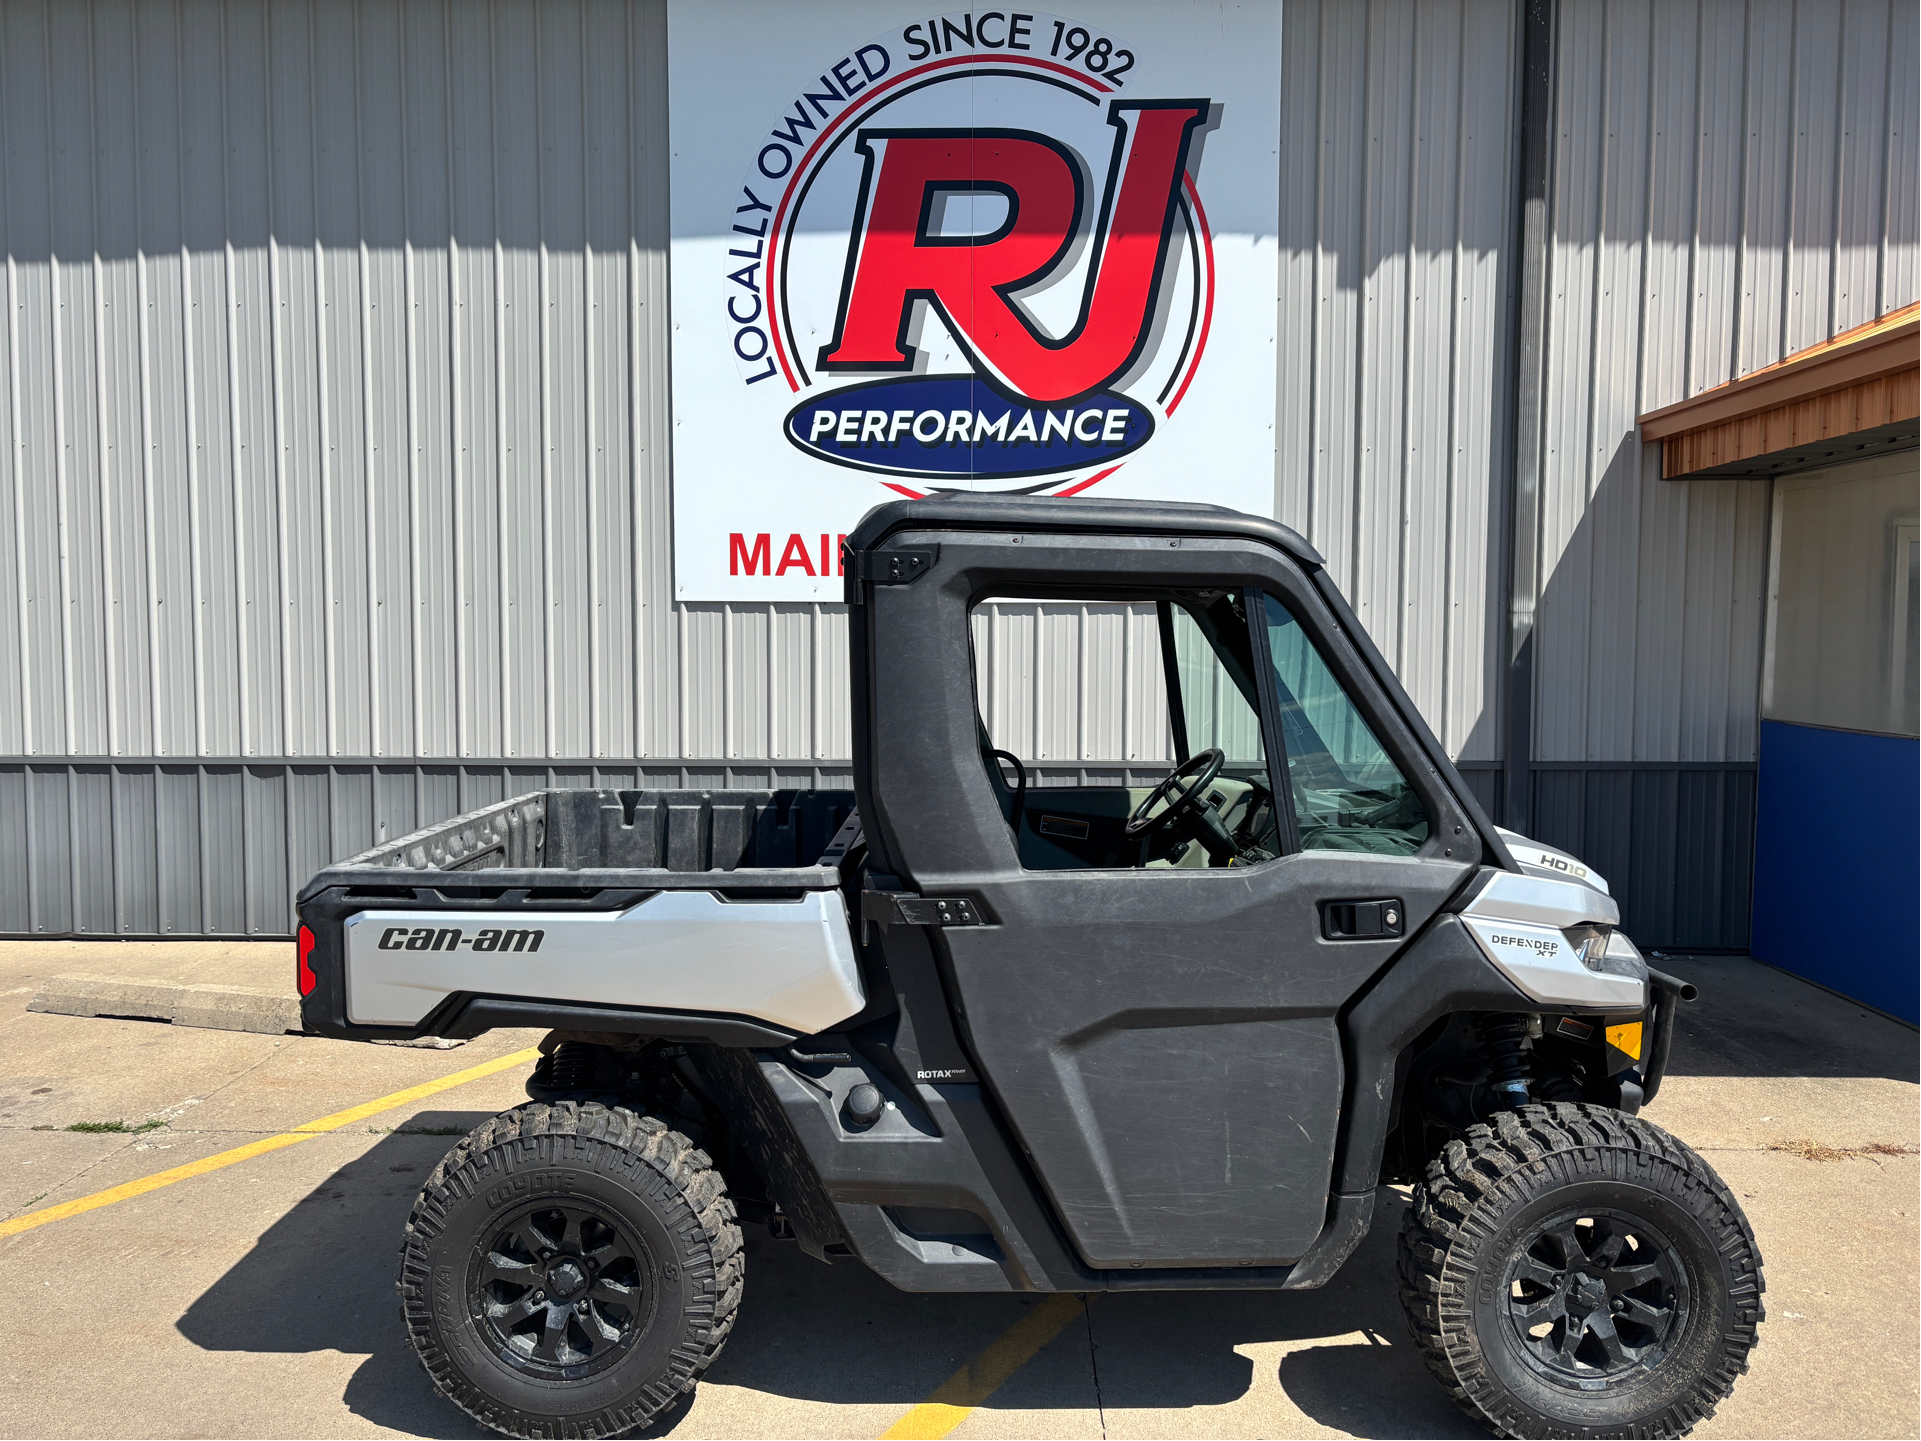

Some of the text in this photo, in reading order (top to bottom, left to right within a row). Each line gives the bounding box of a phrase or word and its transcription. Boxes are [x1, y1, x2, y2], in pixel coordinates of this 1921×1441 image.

[727, 12, 1135, 384] LOCALLY OWNED SINCE 1982
[816, 98, 1210, 408] RJ
[809, 410, 1129, 442] PERFORMANCE
[1541, 855, 1587, 878] HD10
[378, 928, 545, 952] can-am
[1491, 935, 1559, 950] DEFENDER
[917, 1070, 952, 1079] ROTAX
[486, 1173, 577, 1209] COYOTE
